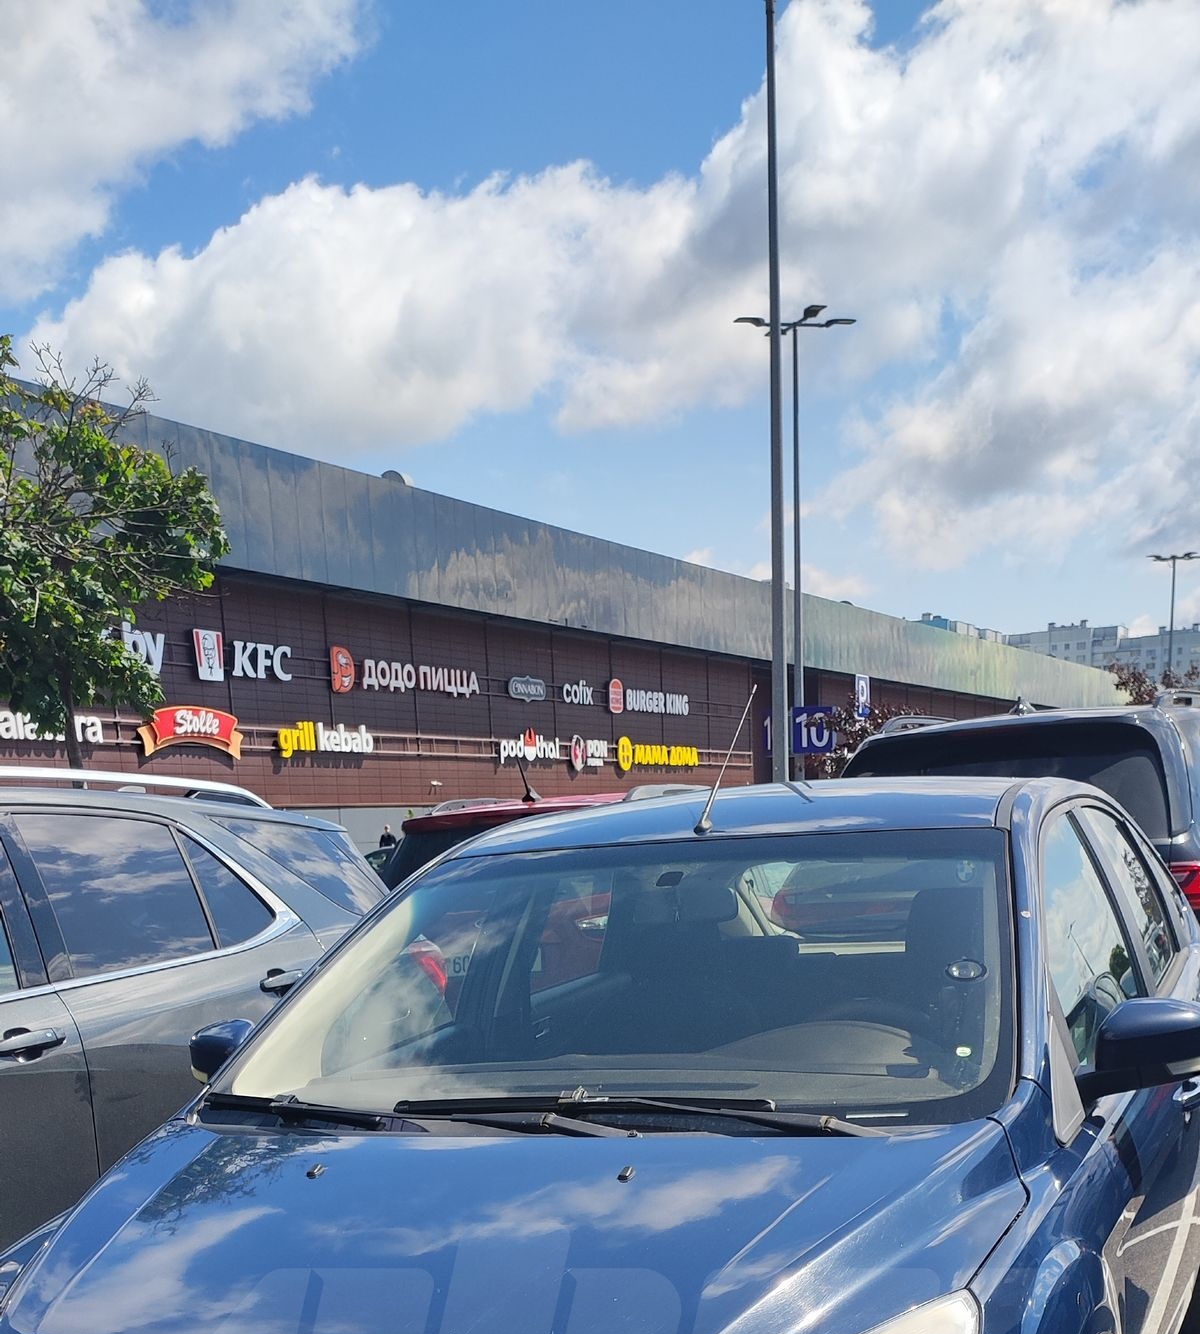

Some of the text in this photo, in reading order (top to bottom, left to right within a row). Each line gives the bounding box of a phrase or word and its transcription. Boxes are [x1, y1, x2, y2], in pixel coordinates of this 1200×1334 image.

[232, 641, 292, 681] KFC
[363, 659, 480, 698] ДОДО ПИЦЦА
[563, 680, 594, 705] cofix
[626, 689, 665, 713] BURGER
[666, 692, 689, 716] KING
[174, 709, 220, 735] Stolle
[279, 721, 374, 758] grill kebab
[796, 712, 830, 748] 10
